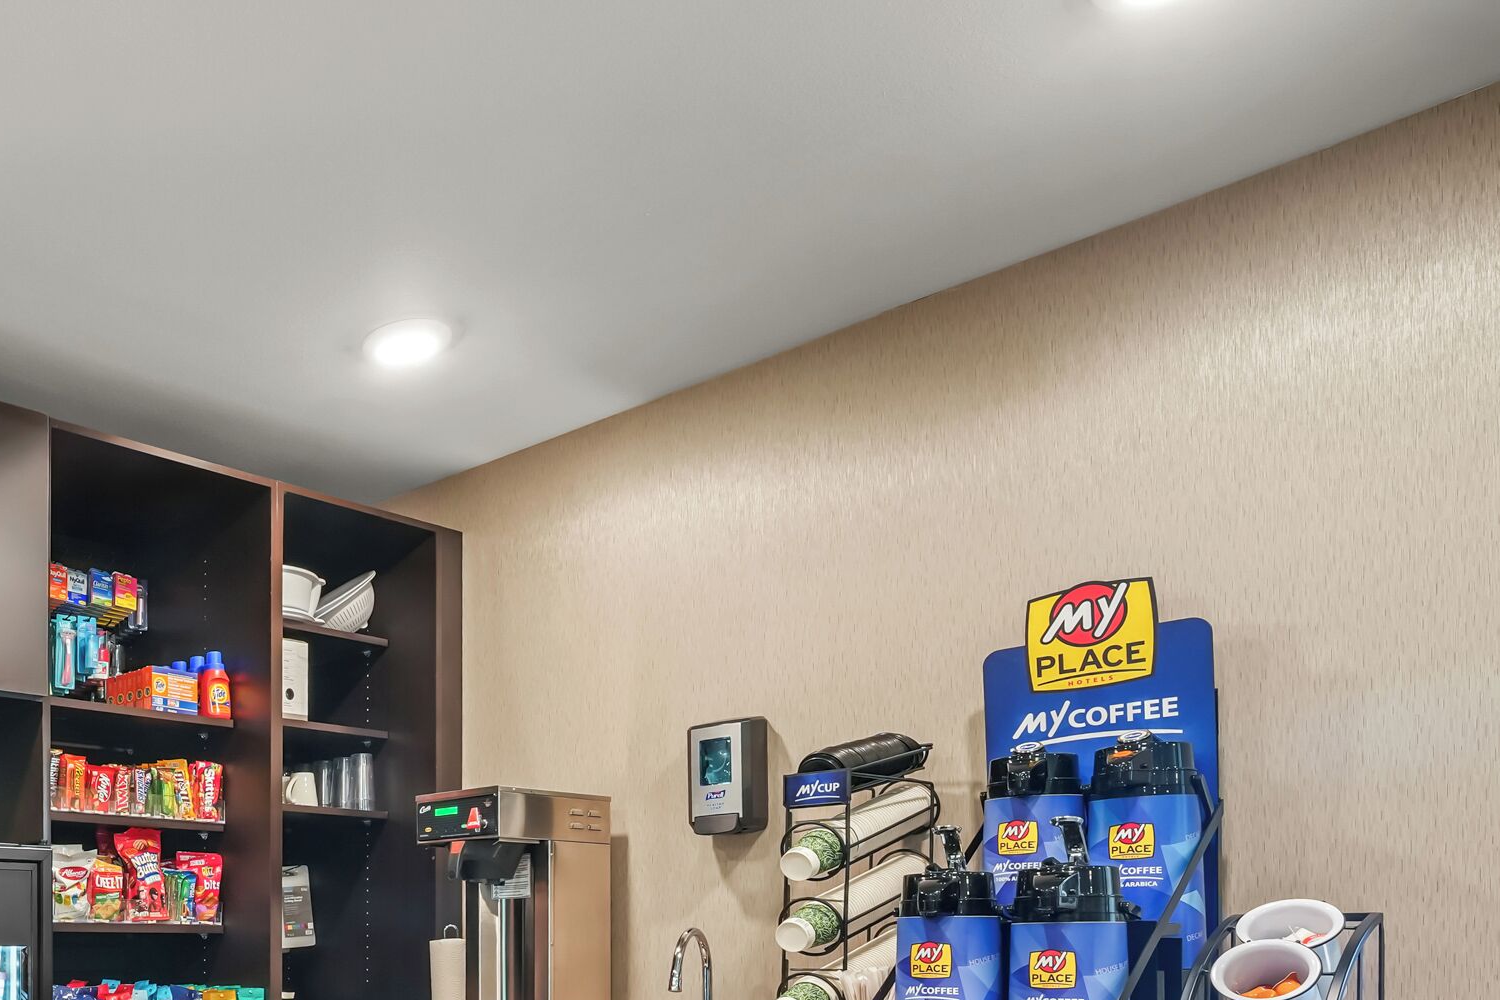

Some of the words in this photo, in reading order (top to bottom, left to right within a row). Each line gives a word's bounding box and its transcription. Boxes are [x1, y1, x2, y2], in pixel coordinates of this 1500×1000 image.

[1040, 582, 1129, 644] MY
[1036, 640, 1147, 678] PLACE
[1067, 675, 1115, 687] HOTELS
[213, 688, 226, 699] Tide
[50, 757, 61, 797] HERSHEY'S
[204, 768, 215, 812] Skittles
[1000, 841, 1035, 852] PLACE
[1111, 844, 1152, 855] PLACE
[131, 852, 158, 867] Nutter
[204, 880, 220, 890] bits
[912, 964, 949, 973] PLACE
[1031, 973, 1073, 983] PLACE
